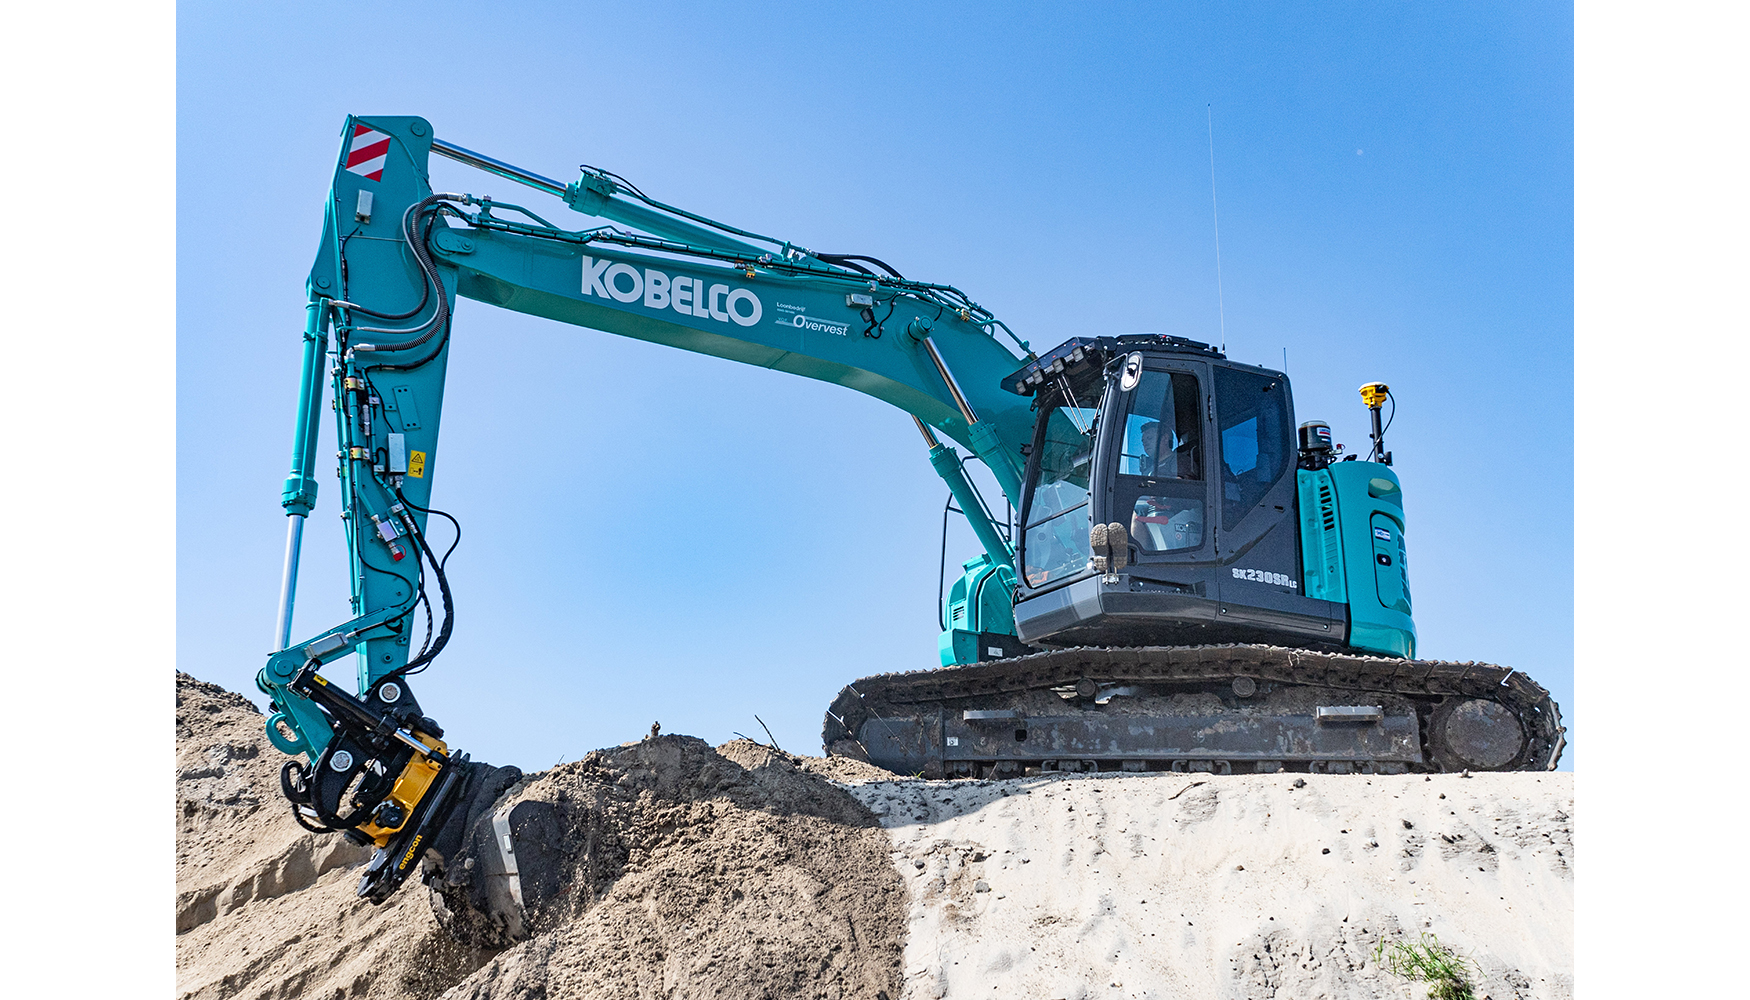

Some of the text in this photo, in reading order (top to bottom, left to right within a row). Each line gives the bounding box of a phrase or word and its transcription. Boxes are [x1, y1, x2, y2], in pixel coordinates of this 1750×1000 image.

[582, 255, 762, 327] KOBELCO
[793, 314, 848, 336] Overvest
[399, 834, 423, 870] engcon
